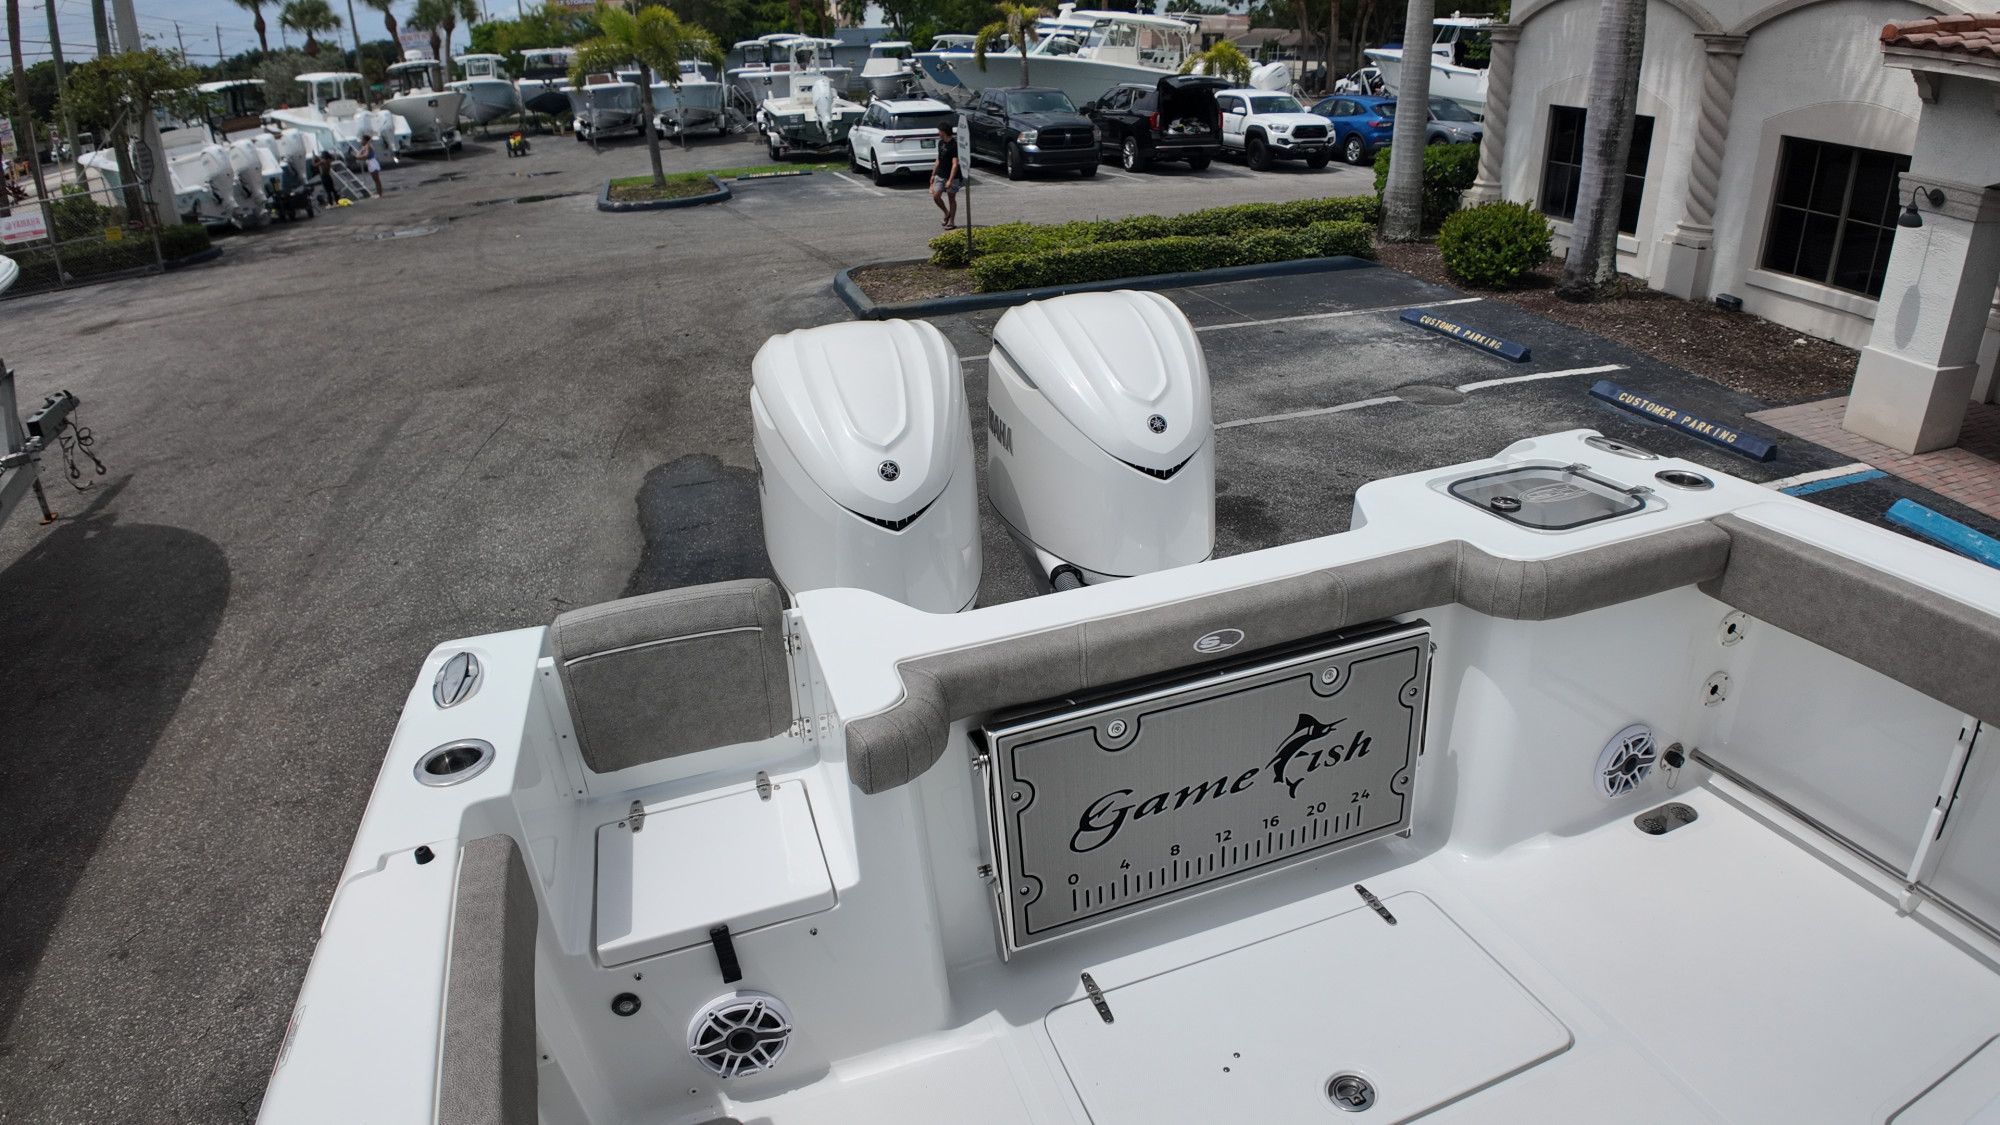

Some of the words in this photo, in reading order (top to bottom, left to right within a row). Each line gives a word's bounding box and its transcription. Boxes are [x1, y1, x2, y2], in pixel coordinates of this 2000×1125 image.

[1420, 315, 1461, 334] CUSTOMER
[1463, 330, 1503, 349] PARKING
[1619, 392, 1677, 419] CUSTOMER
[1681, 415, 1737, 443] PARKING
[1068, 873, 1079, 885] 0
[1120, 859, 1130, 869] 4
[1170, 845, 1180, 855] 8
[1215, 829, 1231, 843] 12
[1263, 816, 1279, 829] 16
[1306, 801, 1326, 817] 20
[1351, 789, 1370, 803] 24
[1070, 768, 1260, 852] Game
